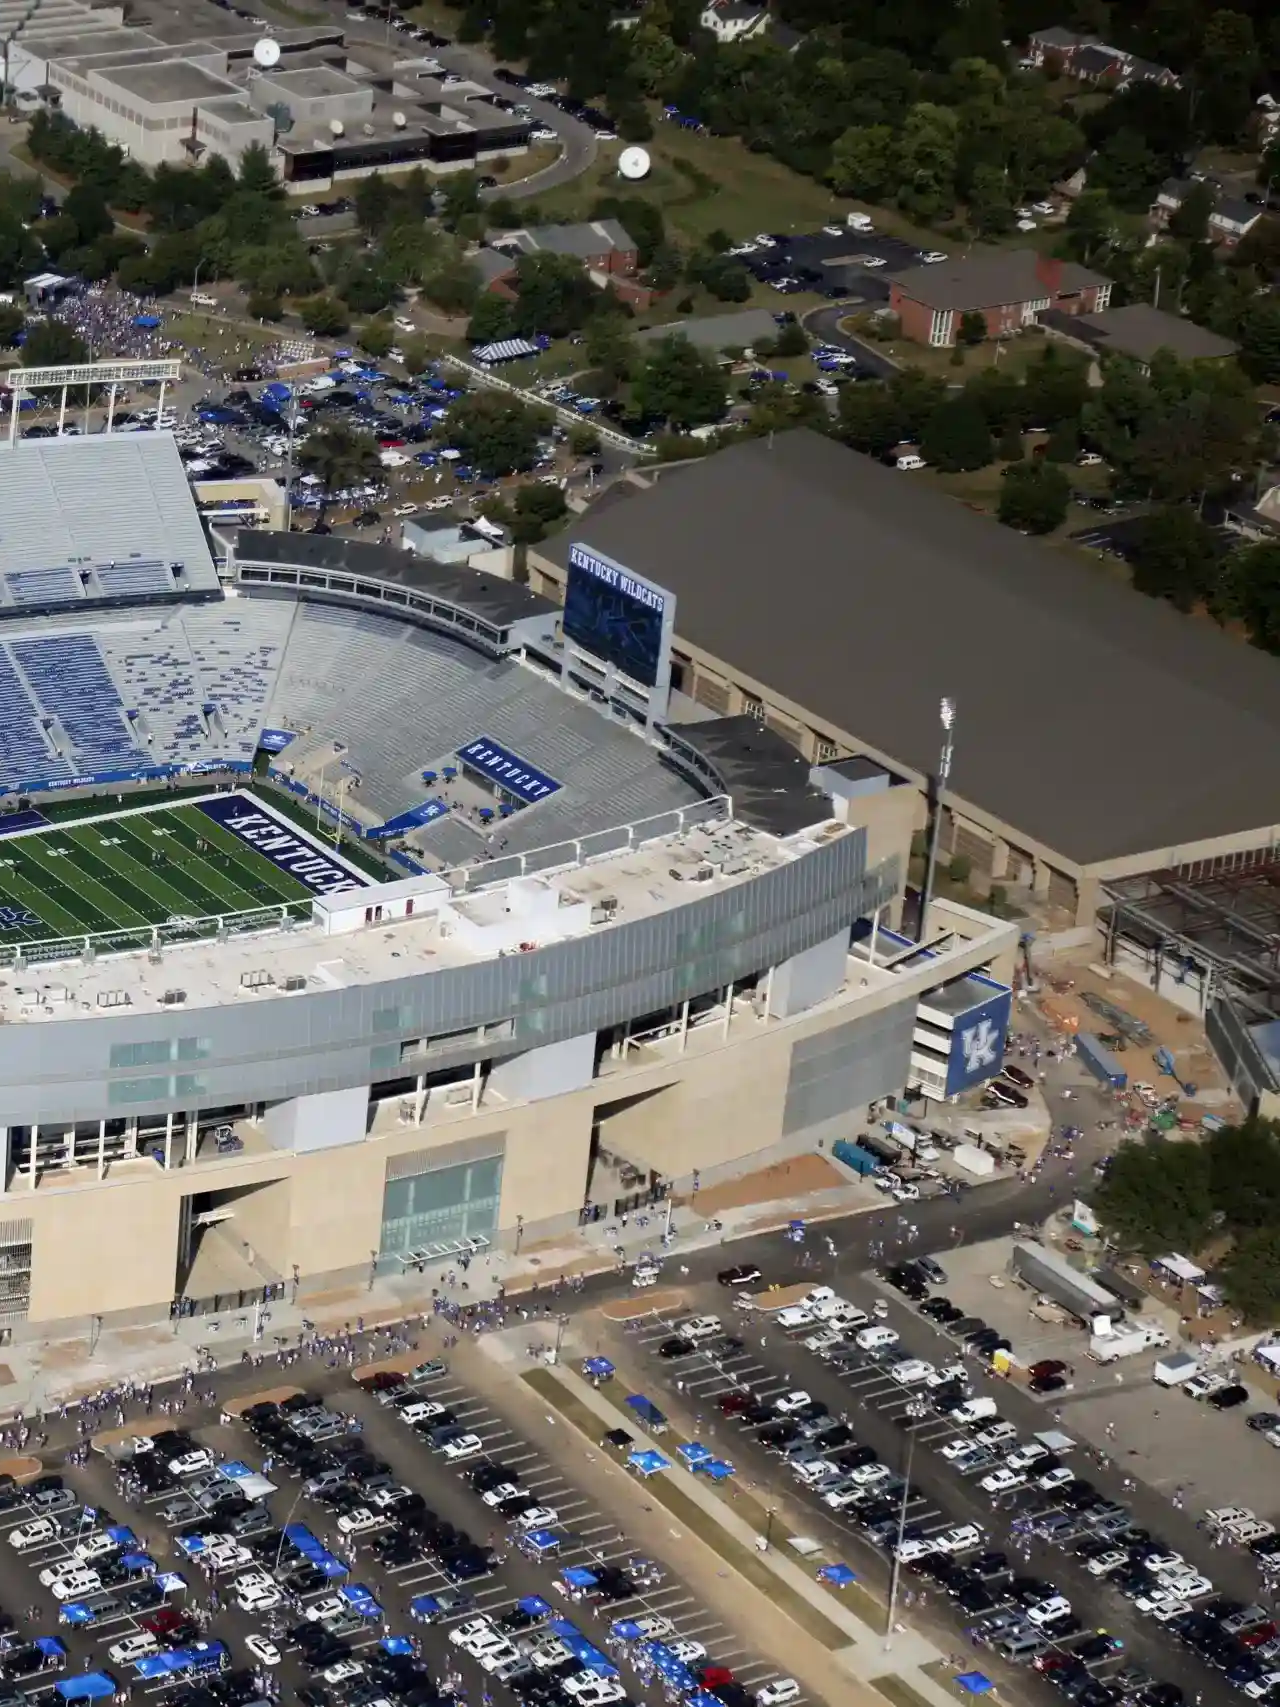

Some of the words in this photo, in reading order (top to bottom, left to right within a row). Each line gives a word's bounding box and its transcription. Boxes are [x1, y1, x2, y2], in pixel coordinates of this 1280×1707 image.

[571, 547, 619, 586] KENTUCKY
[620, 574, 664, 612] WILDCATS
[48, 779, 71, 787] KENTUCKY
[467, 743, 550, 796] KENTUCKY
[224, 813, 362, 896] KENTUCK
[961, 1018, 999, 1073] UK
